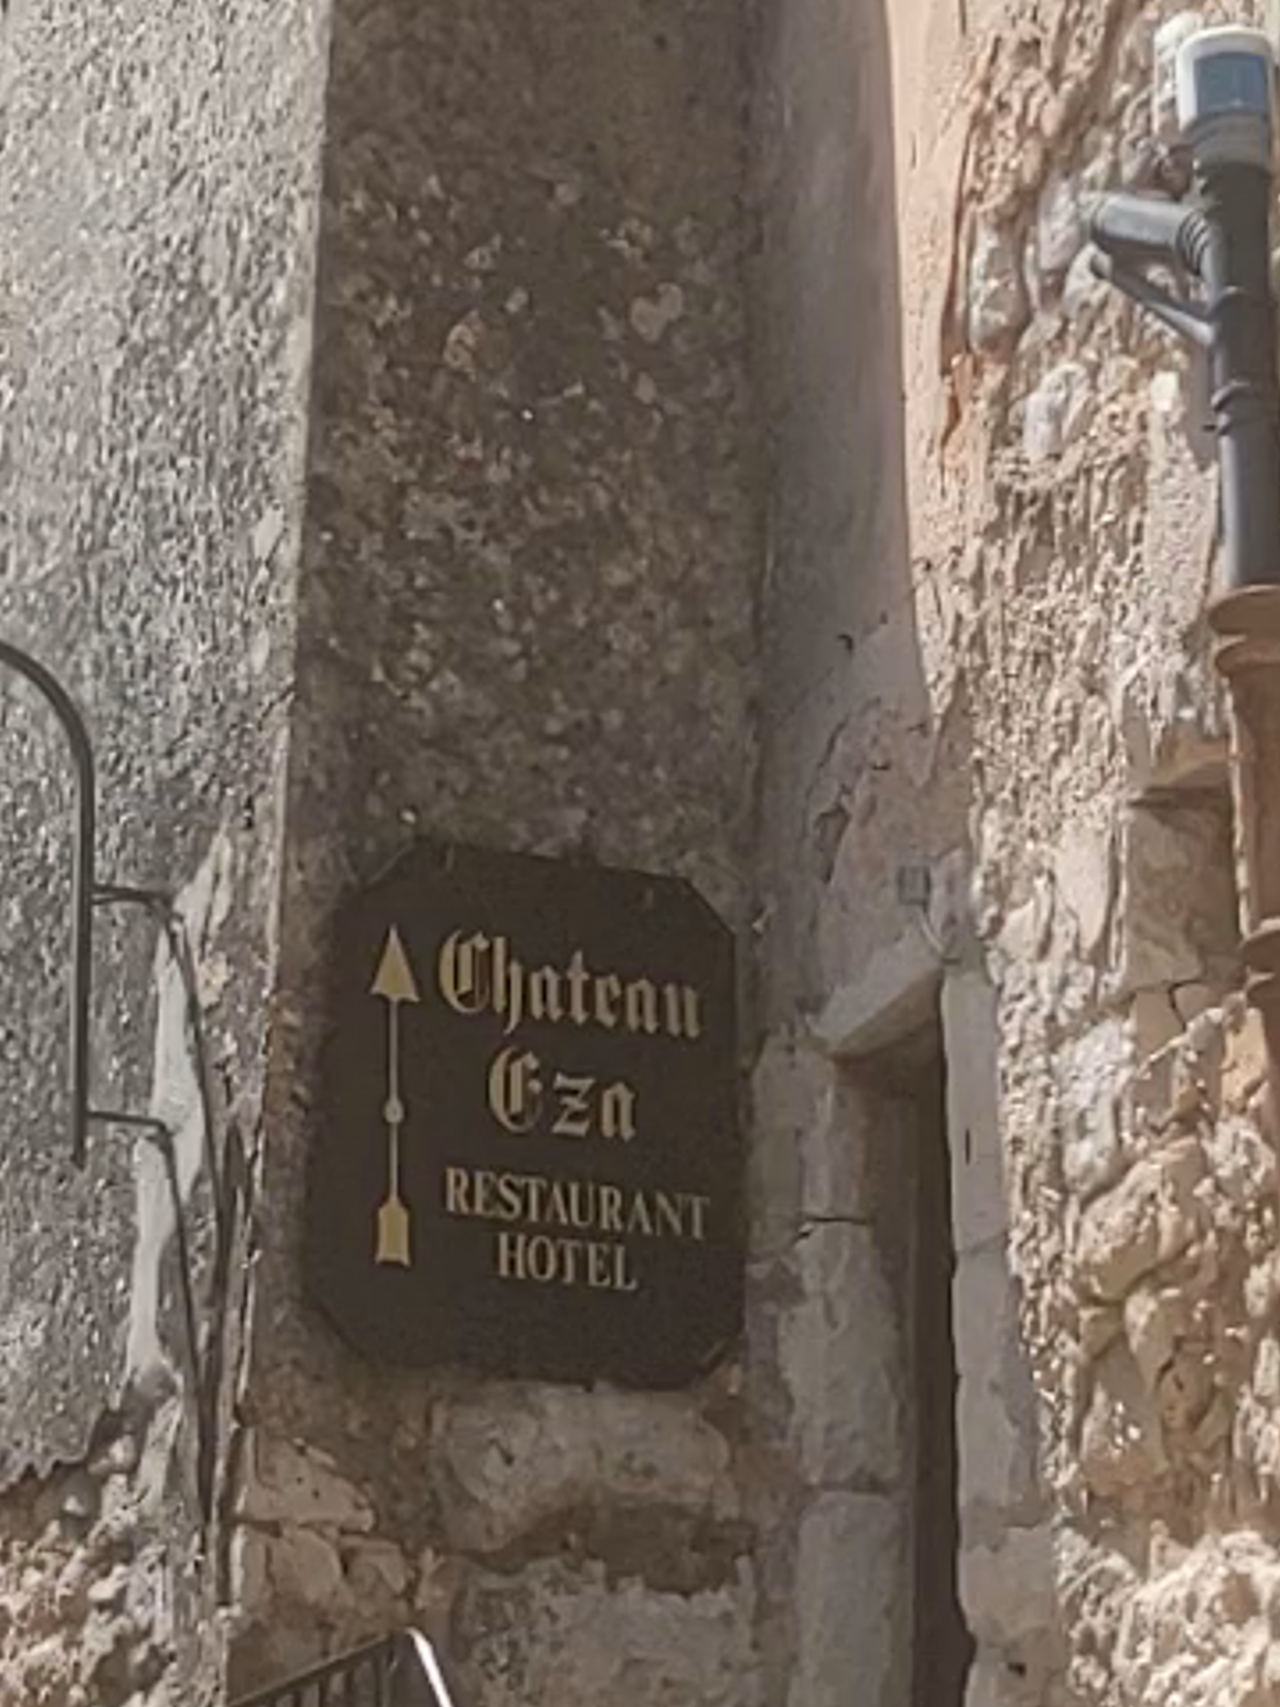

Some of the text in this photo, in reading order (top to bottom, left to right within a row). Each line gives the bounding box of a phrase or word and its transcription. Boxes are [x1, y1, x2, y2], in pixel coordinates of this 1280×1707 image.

[438, 929, 701, 1039] Chateau
[488, 1045, 636, 1141] Eza
[445, 1167, 711, 1240] RESTAURANT
[498, 1231, 639, 1291] HOTEL
